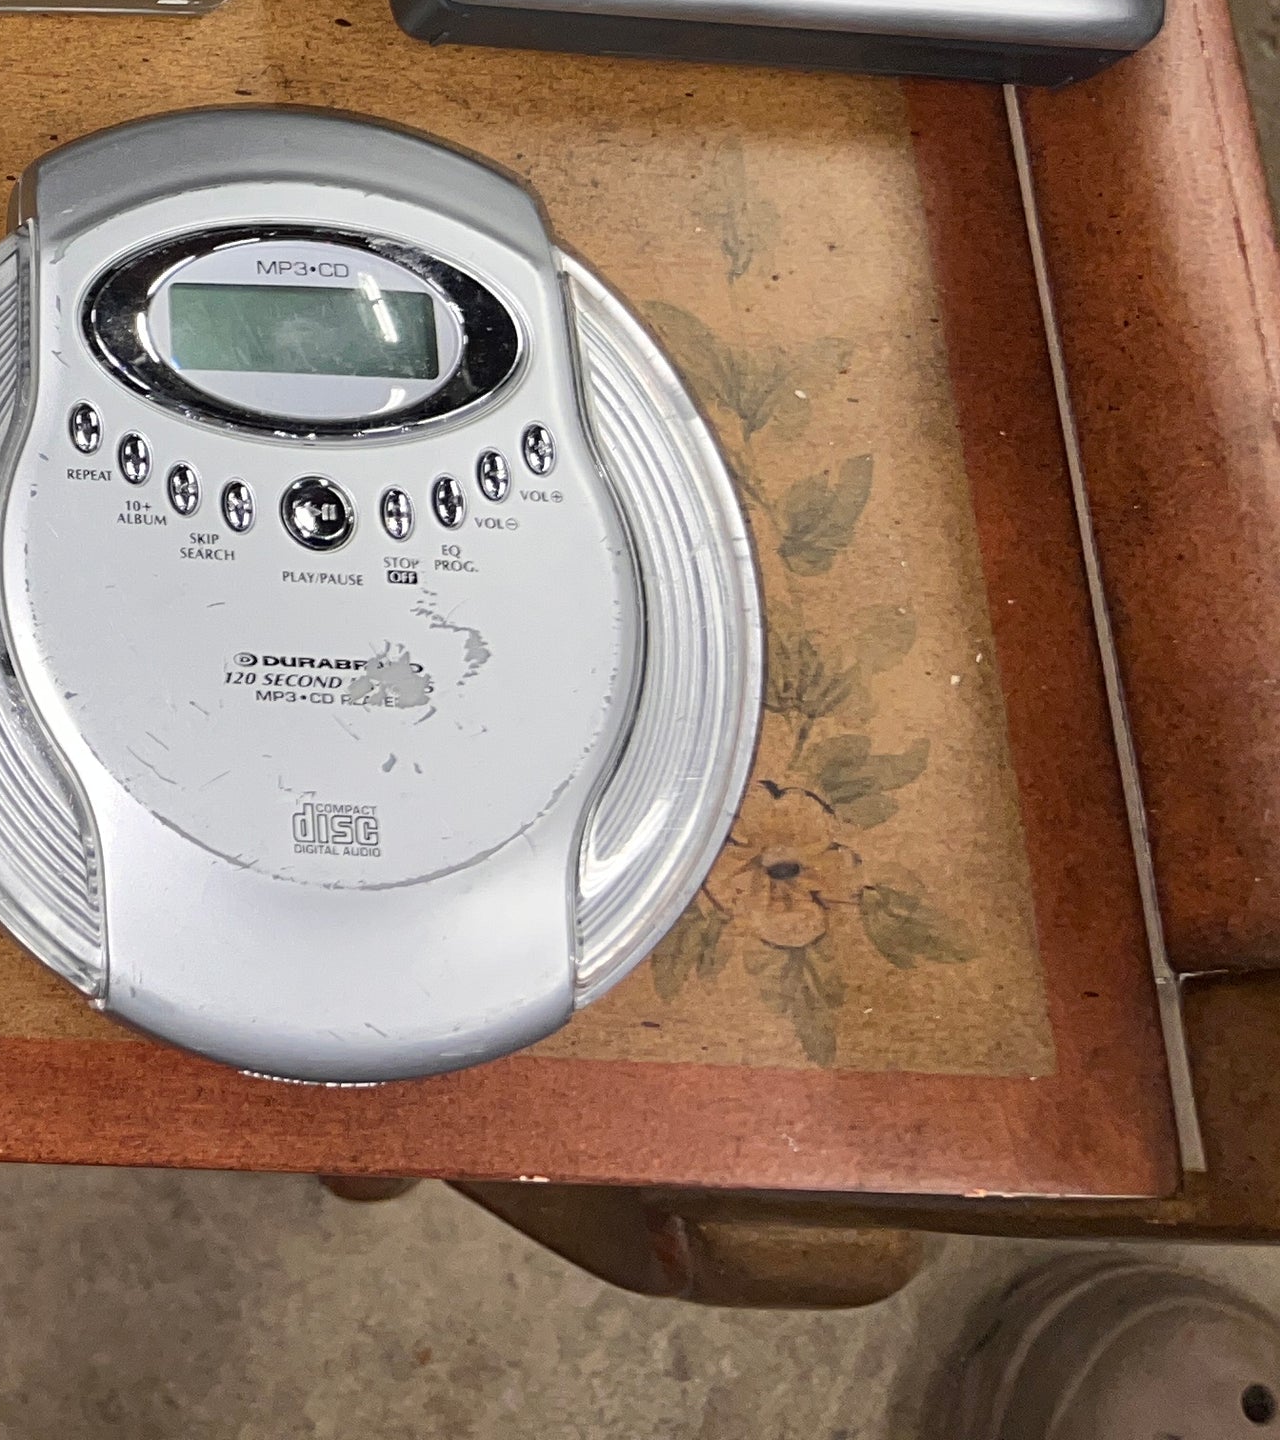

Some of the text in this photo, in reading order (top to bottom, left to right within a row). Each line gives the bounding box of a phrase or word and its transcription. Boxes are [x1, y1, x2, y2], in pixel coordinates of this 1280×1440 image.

[67, 469, 112, 482] REPEAT
[117, 512, 167, 526] ALBUM
[190, 533, 219, 545] SKIP
[180, 547, 236, 561] SEARCH
[441, 544, 461, 559] EQ
[383, 557, 419, 570] STOP
[434, 559, 479, 573] PROG.
[282, 571, 363, 586] PLAY/PAUSE
[225, 671, 256, 686] 120
[262, 673, 343, 689] SECOND
[316, 803, 377, 815] COMPACT
[294, 844, 381, 857] DIGITAL AUDIO
